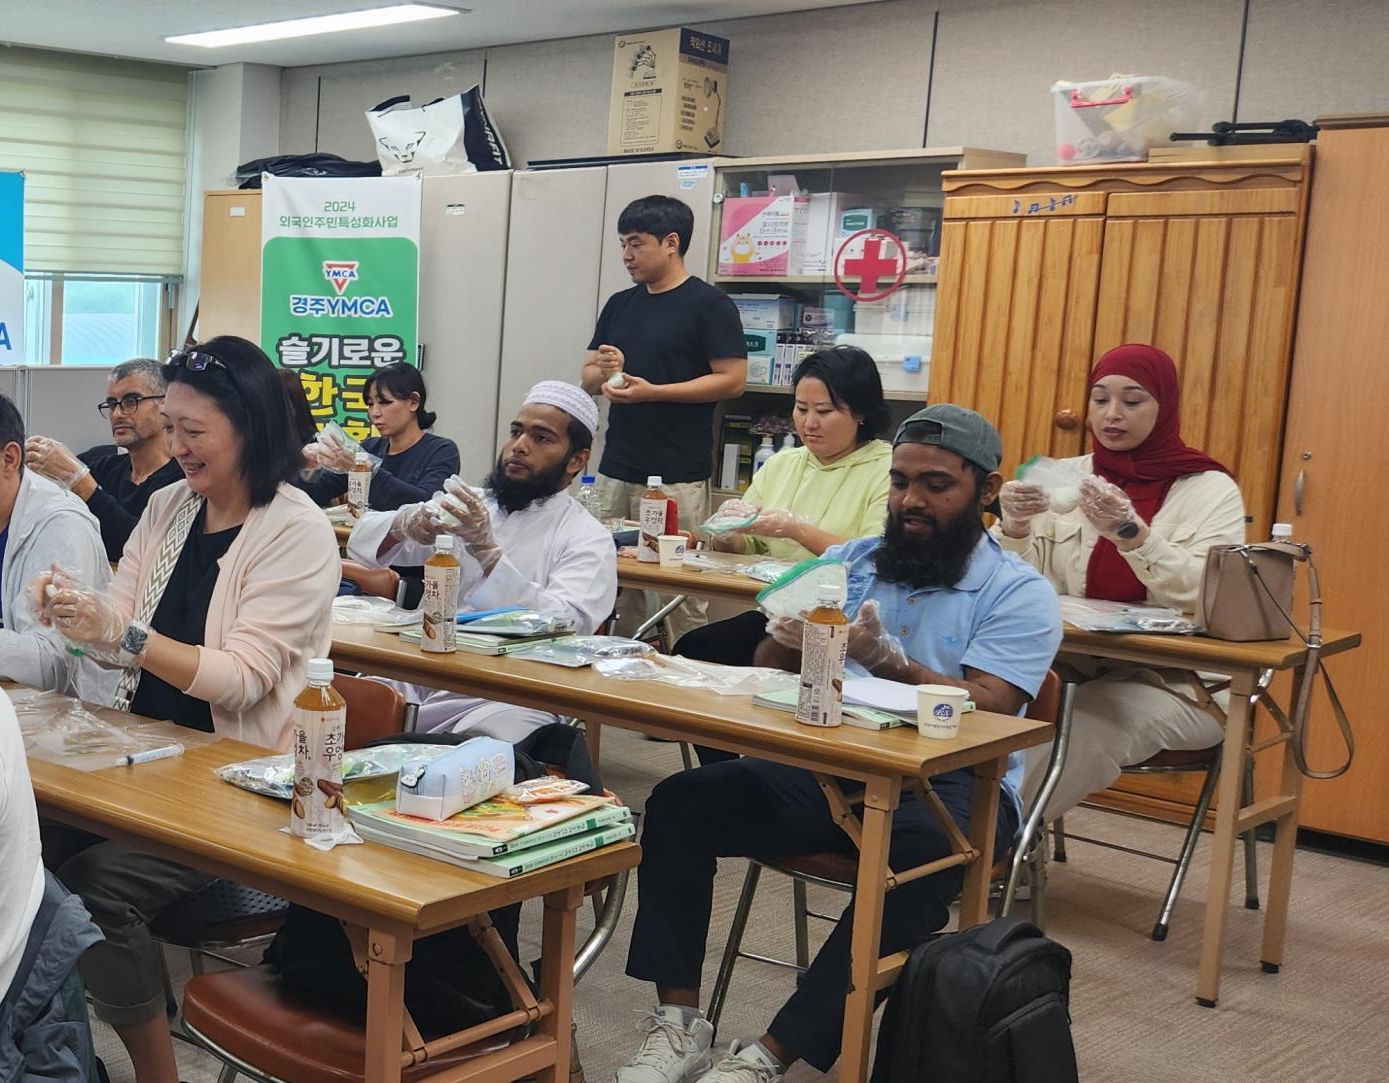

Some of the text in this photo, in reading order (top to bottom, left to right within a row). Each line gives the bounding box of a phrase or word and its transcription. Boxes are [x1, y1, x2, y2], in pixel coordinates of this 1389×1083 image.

[323, 201, 357, 213] 2024
[279, 214, 399, 229] 외국인주민특성화사업
[325, 269, 357, 279] YMCA
[291, 296, 392, 316] 경주YMCA
[279, 336, 404, 367] 슬기로운
